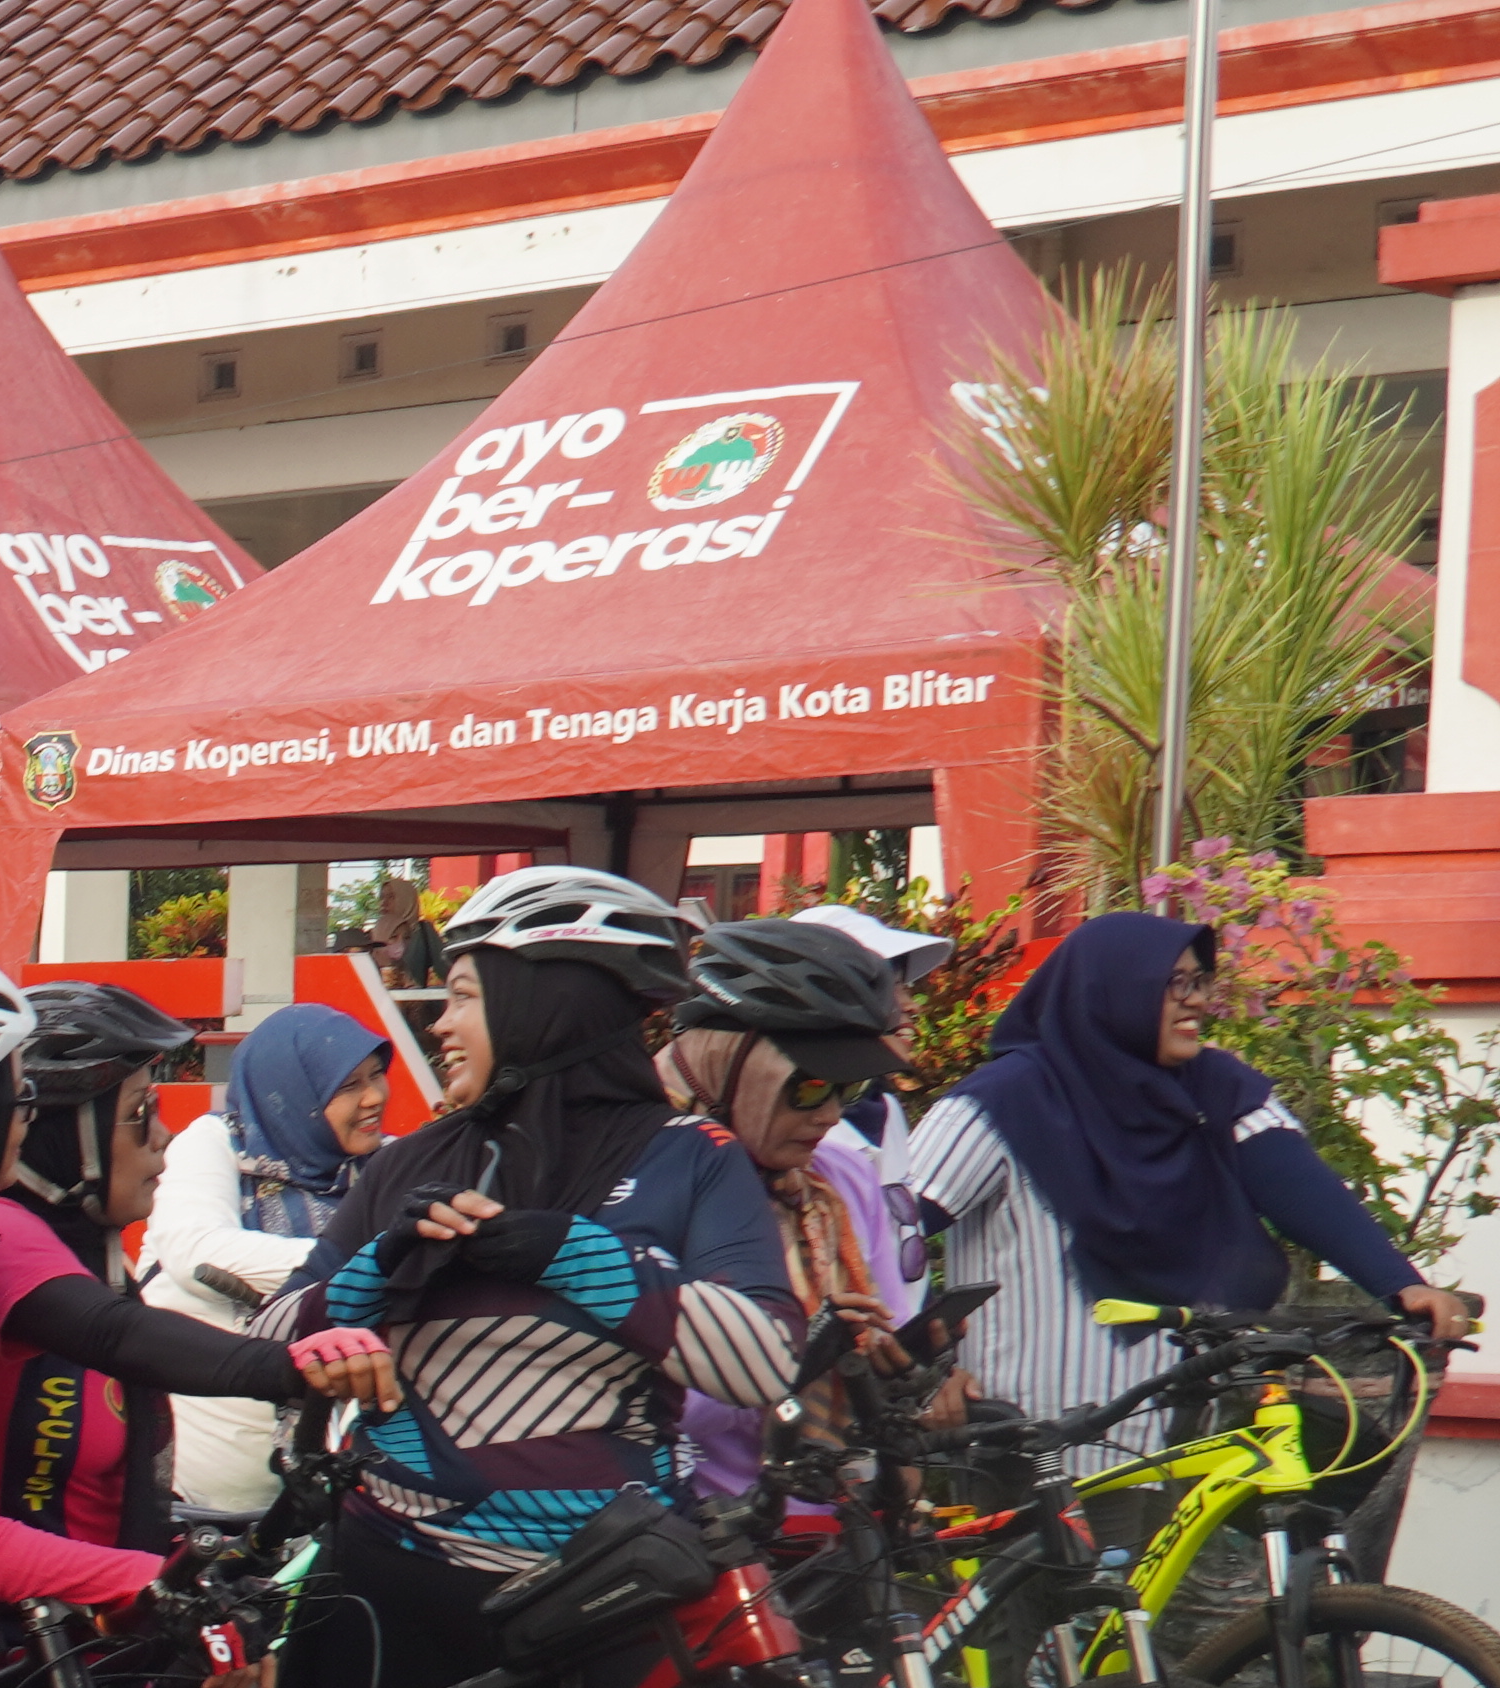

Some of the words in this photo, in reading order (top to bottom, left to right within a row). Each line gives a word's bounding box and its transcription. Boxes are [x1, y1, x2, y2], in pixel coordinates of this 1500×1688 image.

[455, 406, 627, 486] ayo
[368, 493, 796, 608] koperasi
[409, 474, 616, 543] ber-
[12, 573, 164, 636] ber-
[86, 745, 176, 778] Dinas
[183, 728, 339, 778] Koperasi,
[347, 717, 440, 759] UKM,
[449, 712, 518, 752] dan
[528, 703, 659, 749] Tenaga
[668, 691, 767, 735] Kerja
[777, 683, 873, 721] Kota
[881, 669, 996, 710] Blitar
[21, 1374, 81, 1513] CYCLIST
